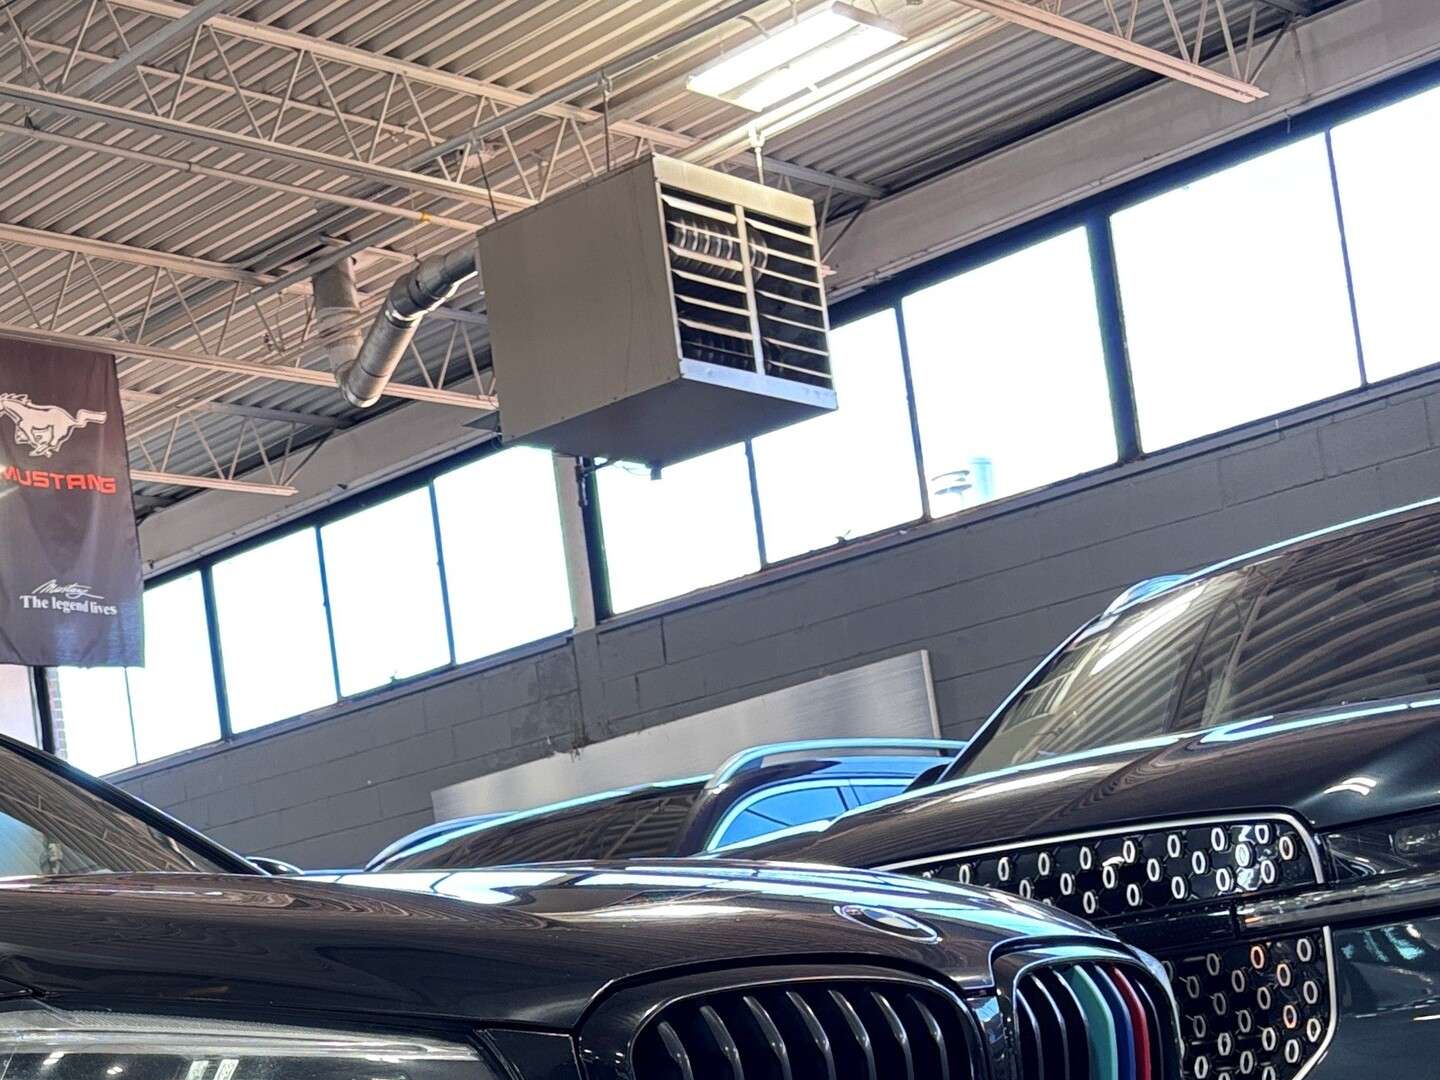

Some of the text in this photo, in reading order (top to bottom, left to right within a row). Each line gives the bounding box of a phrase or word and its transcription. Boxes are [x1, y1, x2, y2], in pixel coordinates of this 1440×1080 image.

[3, 465, 117, 495] MUSTANG
[19, 595, 118, 616] The legend lives
